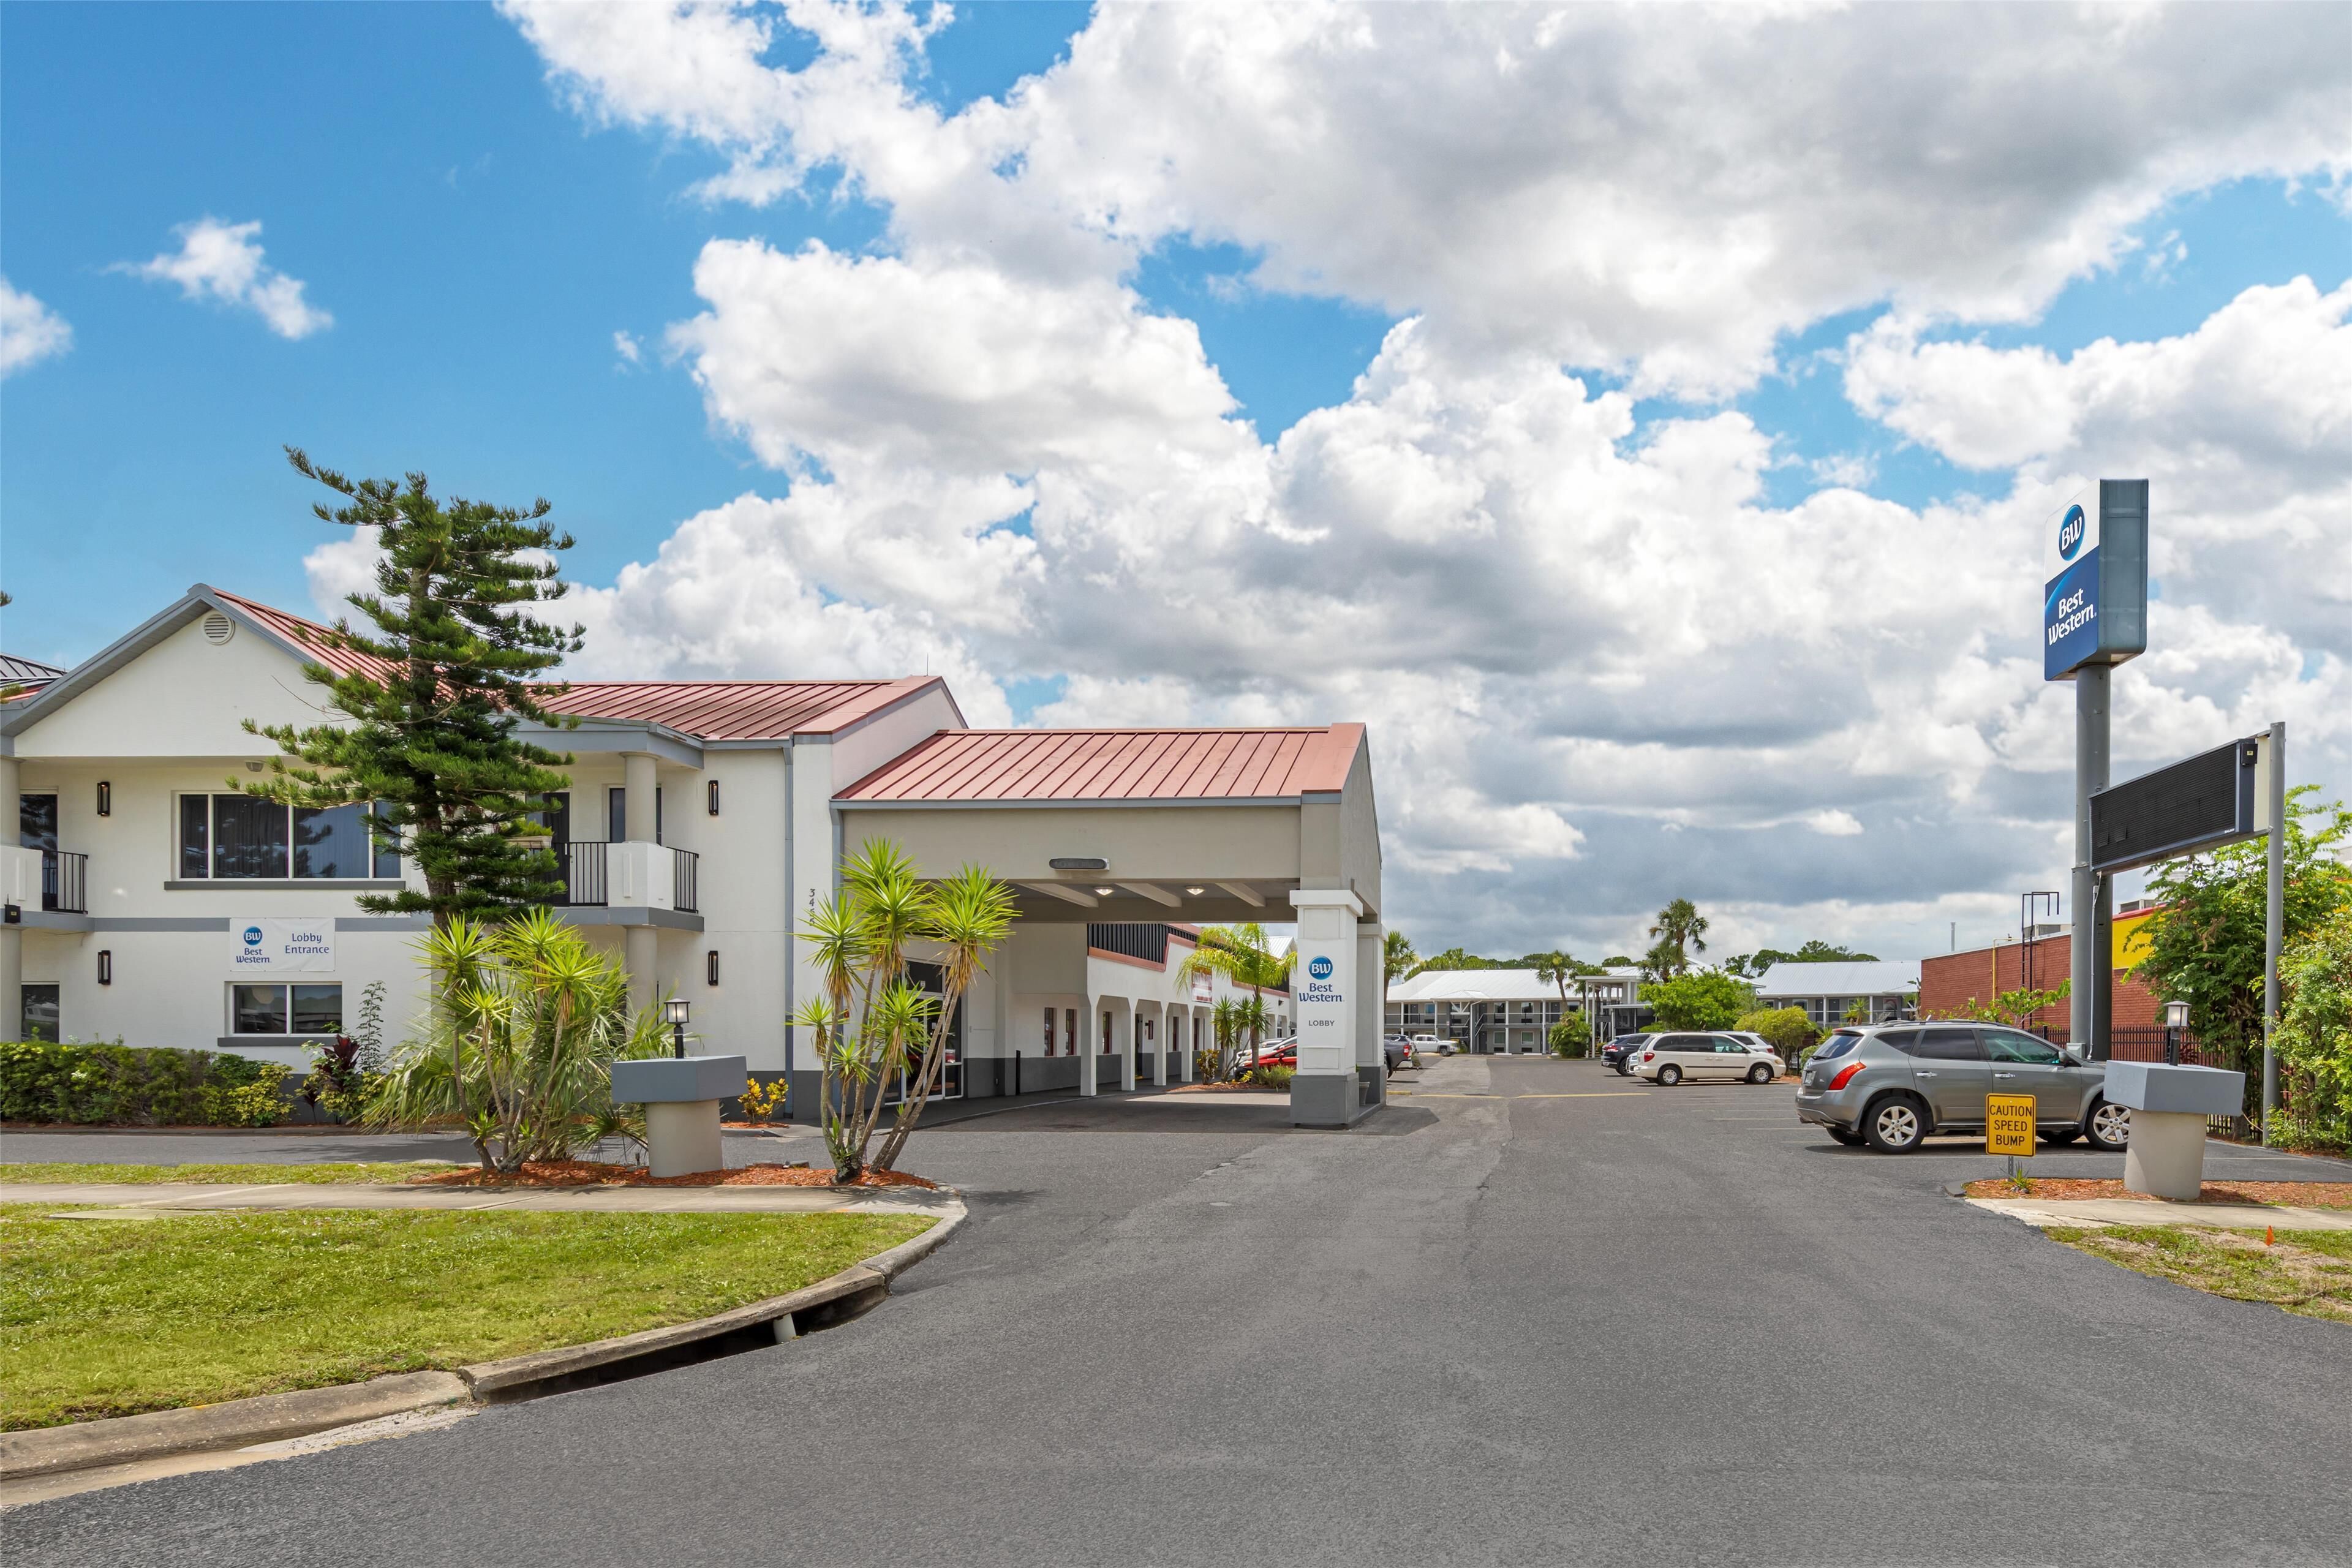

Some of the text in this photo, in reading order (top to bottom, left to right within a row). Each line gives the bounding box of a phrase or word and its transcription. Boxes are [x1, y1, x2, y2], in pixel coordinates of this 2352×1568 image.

[2062, 516, 2082, 551] BW
[2059, 588, 2084, 619] Best
[2048, 604, 2094, 646] Western
[245, 932, 262, 941] BW
[292, 933, 322, 944] Lobby
[285, 945, 330, 954] Entrance
[1311, 963, 1331, 974] BW
[1309, 982, 1333, 992] Best
[1298, 992, 1342, 1002] Western
[1989, 1104, 2032, 1117] CAUTION
[1994, 1120, 2027, 1132] SPEED
[1996, 1134, 2025, 1147] BUMP
